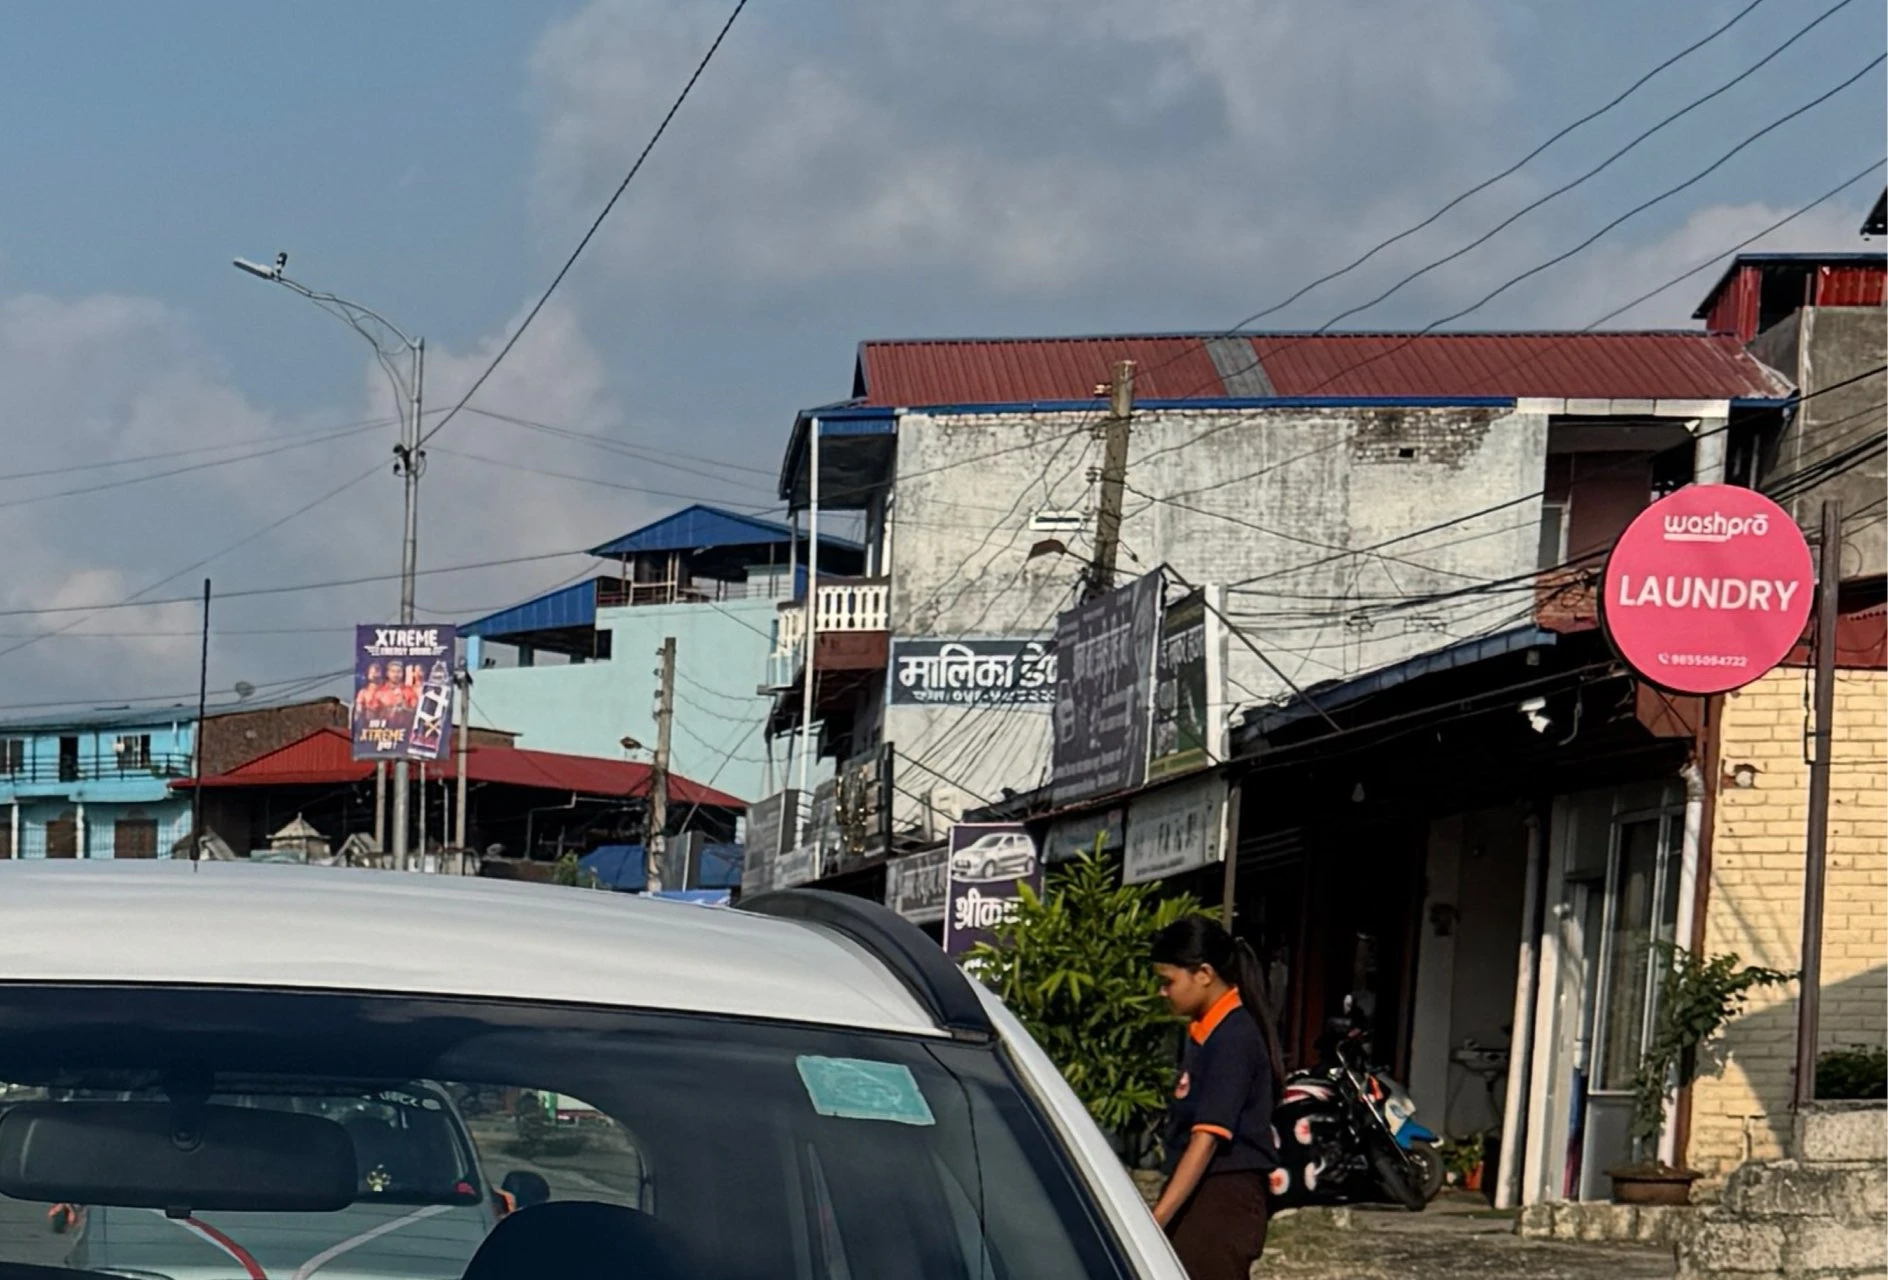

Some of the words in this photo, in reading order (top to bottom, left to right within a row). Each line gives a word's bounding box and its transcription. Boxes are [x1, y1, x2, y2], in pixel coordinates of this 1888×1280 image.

[1619, 575, 1799, 611] LAUNDRY
[375, 629, 438, 647] XTREME
[898, 643, 1017, 688] मालिका
